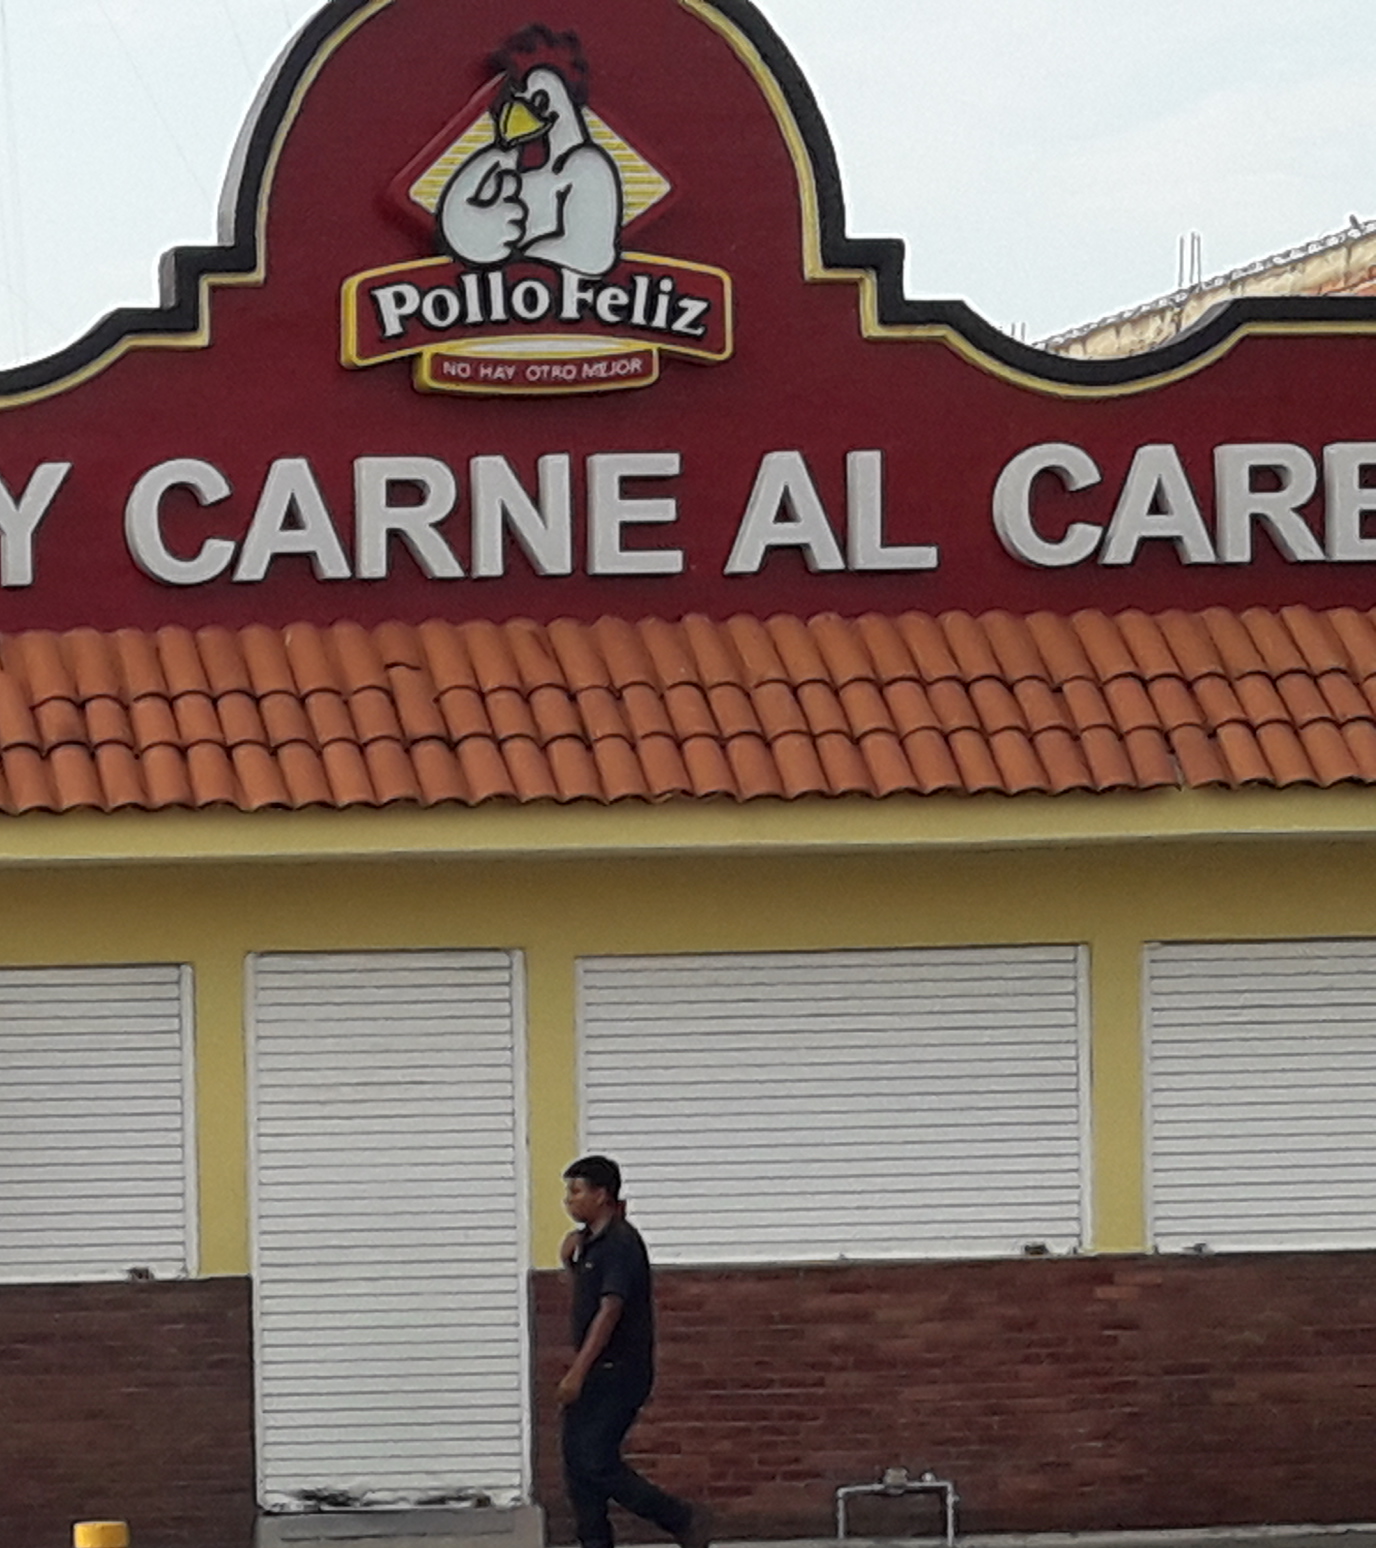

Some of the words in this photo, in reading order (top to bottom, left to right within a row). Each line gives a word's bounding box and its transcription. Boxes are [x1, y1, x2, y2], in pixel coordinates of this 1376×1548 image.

[371, 271, 550, 338] Pollo
[560, 267, 709, 336] Feliz
[442, 361, 471, 378] NO
[123, 452, 685, 585] CARNE
[723, 450, 939, 576] AL
